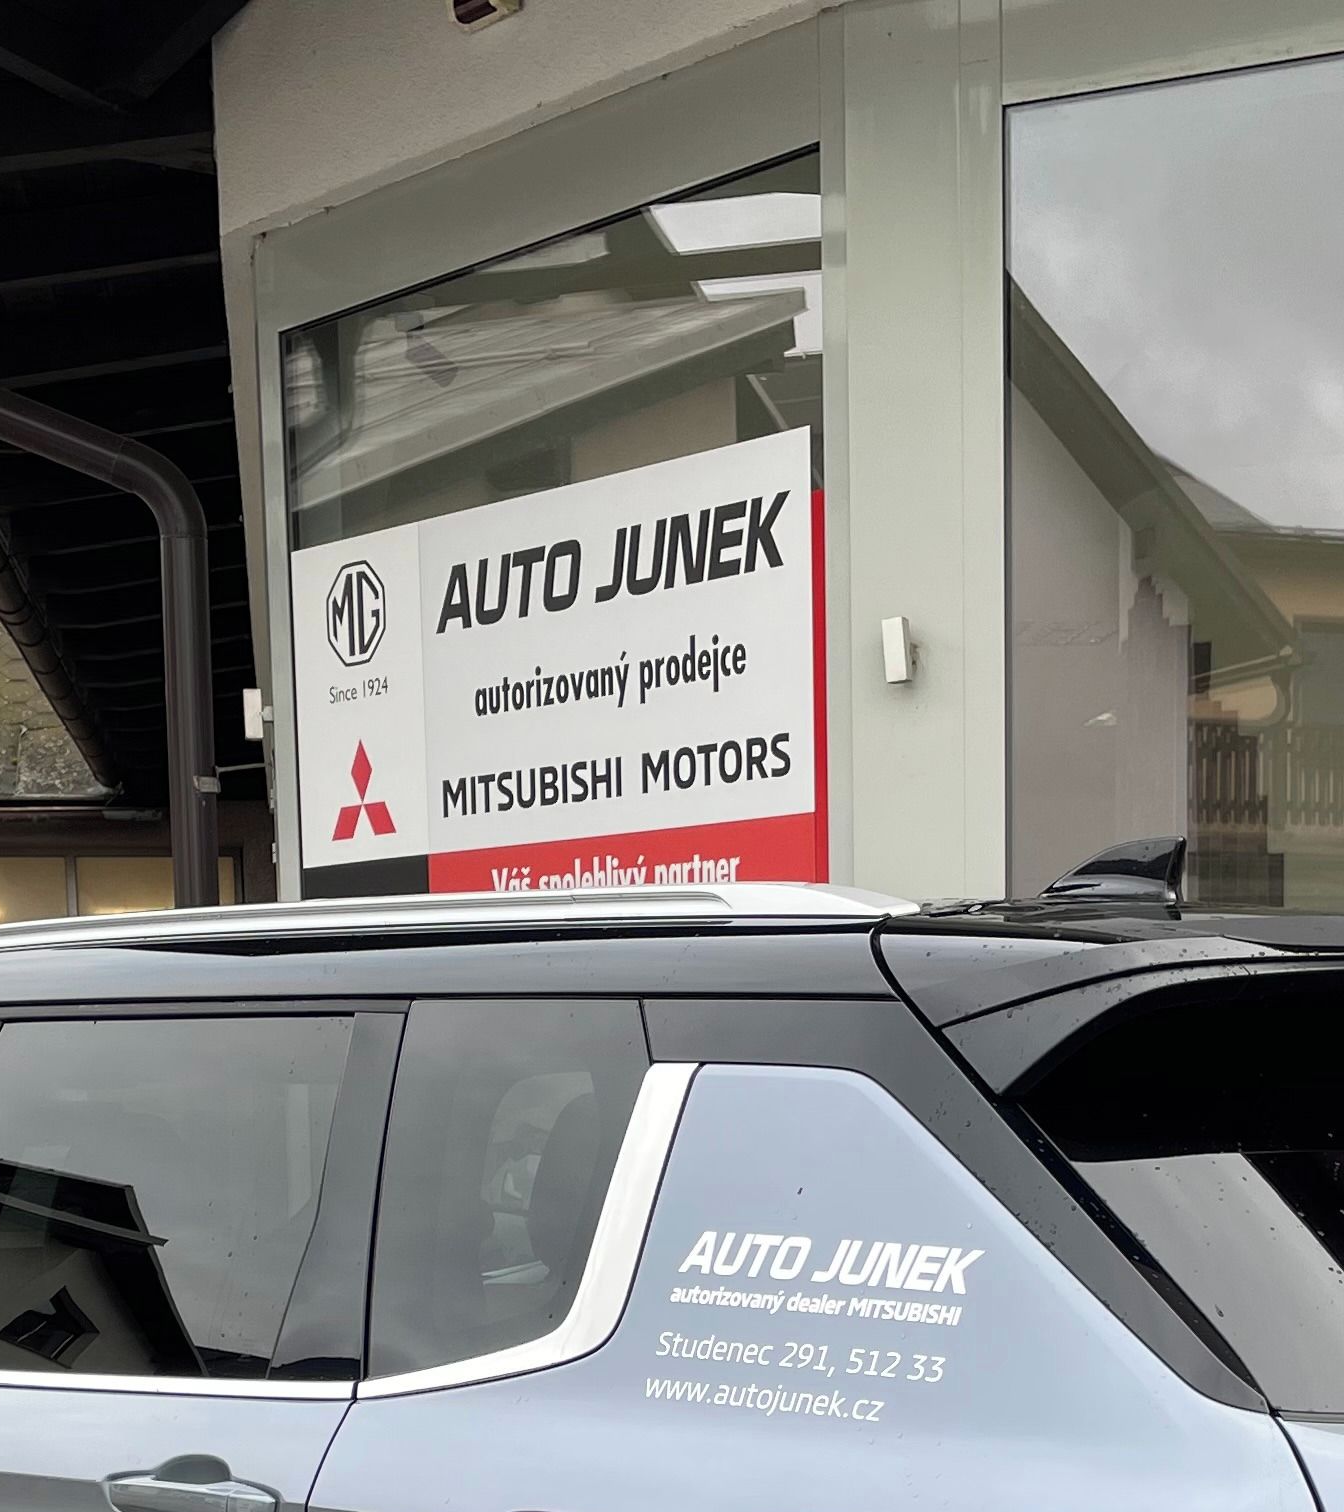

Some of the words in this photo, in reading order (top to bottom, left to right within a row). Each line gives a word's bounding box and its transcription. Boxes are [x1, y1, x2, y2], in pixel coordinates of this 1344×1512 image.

[436, 539, 581, 634] AUTO
[595, 490, 791, 603] JUNEK
[329, 569, 383, 658] MG
[329, 682, 358, 704] Since
[362, 676, 389, 698] 1924
[475, 651, 630, 716] autorizovaný
[640, 635, 747, 704] prodejce
[442, 756, 622, 818] MITSUBISHI
[642, 733, 791, 793] MOTORS
[678, 1231, 812, 1280] AUTO
[811, 1239, 986, 1295] JUNEK
[670, 1285, 784, 1314] autorizovaný
[786, 1292, 846, 1316] dealer
[847, 1297, 963, 1326] MITSUBISHI
[655, 1331, 773, 1366] Studenec
[778, 1341, 837, 1378] 291,
[845, 1348, 901, 1379] 512
[906, 1354, 946, 1383] 33
[644, 1376, 886, 1422] www.autojunek.cz
